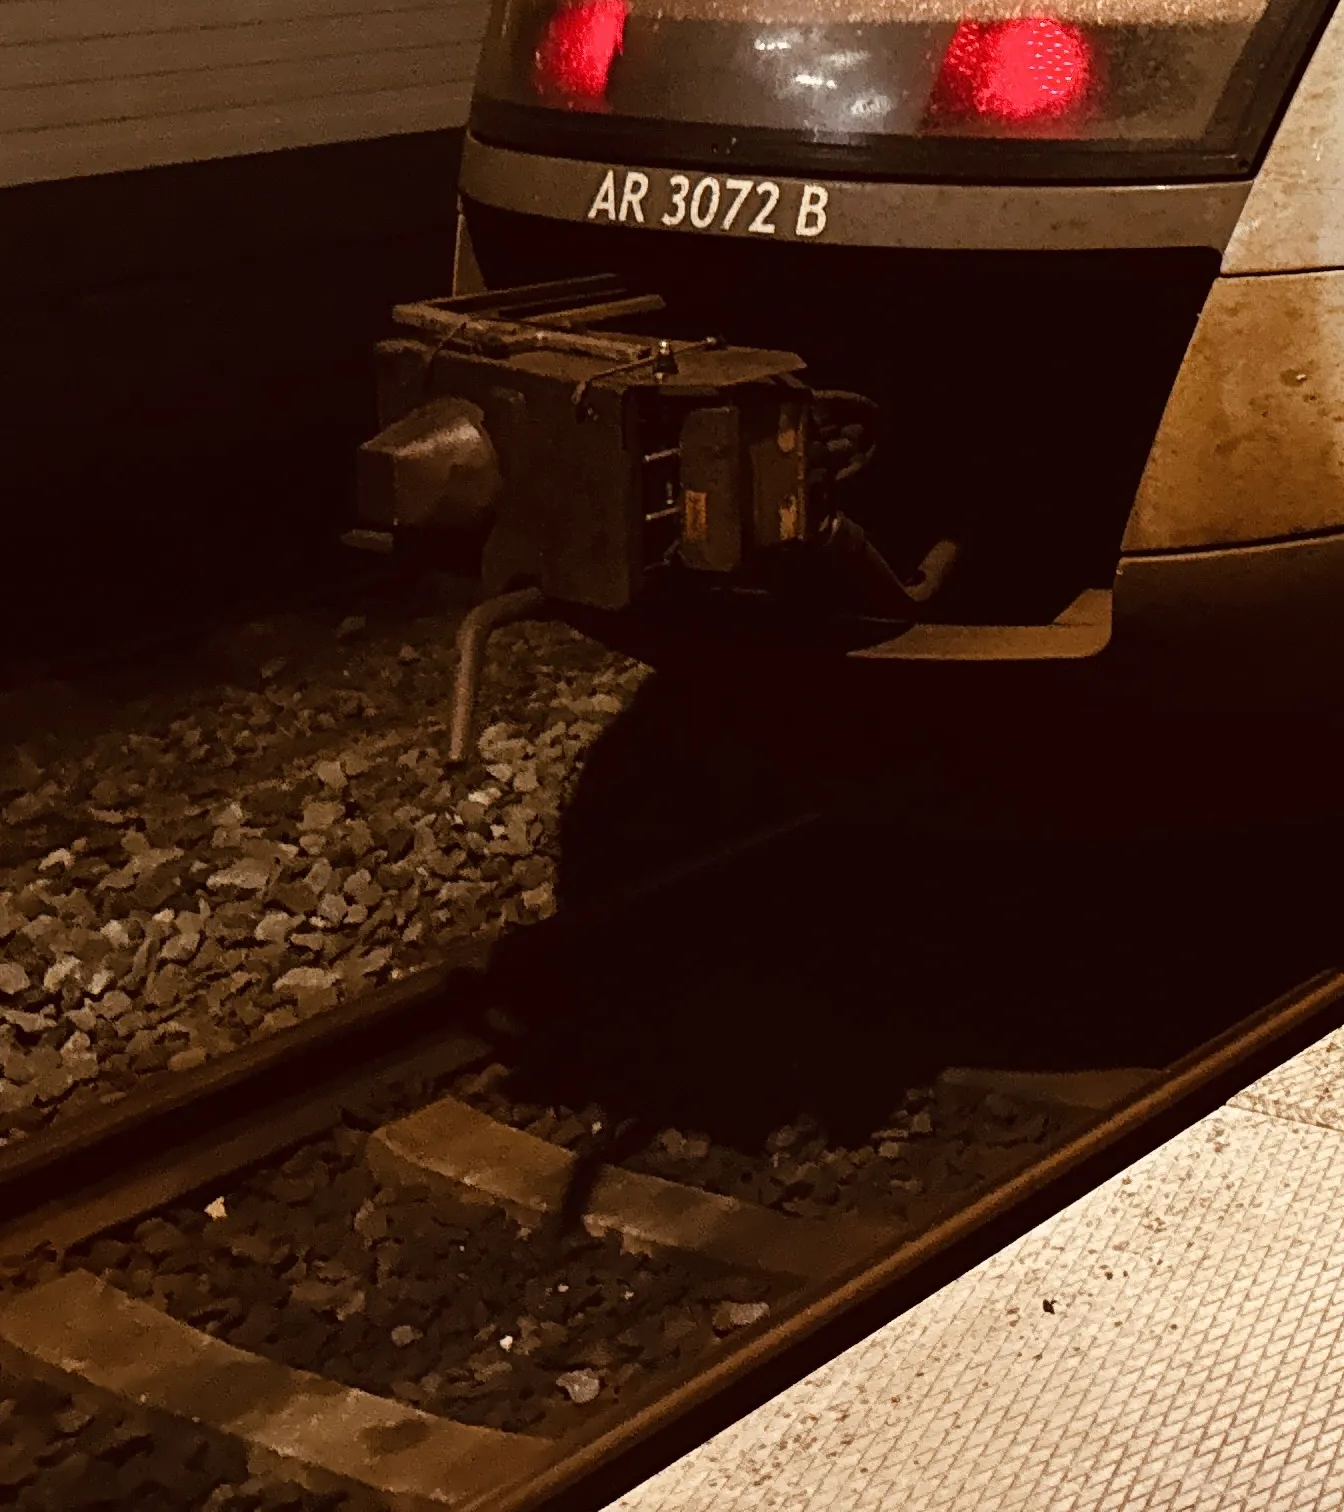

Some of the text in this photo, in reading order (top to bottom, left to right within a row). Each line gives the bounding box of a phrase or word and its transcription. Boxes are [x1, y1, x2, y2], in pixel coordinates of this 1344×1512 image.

[587, 169, 829, 237] AR 3072 B
